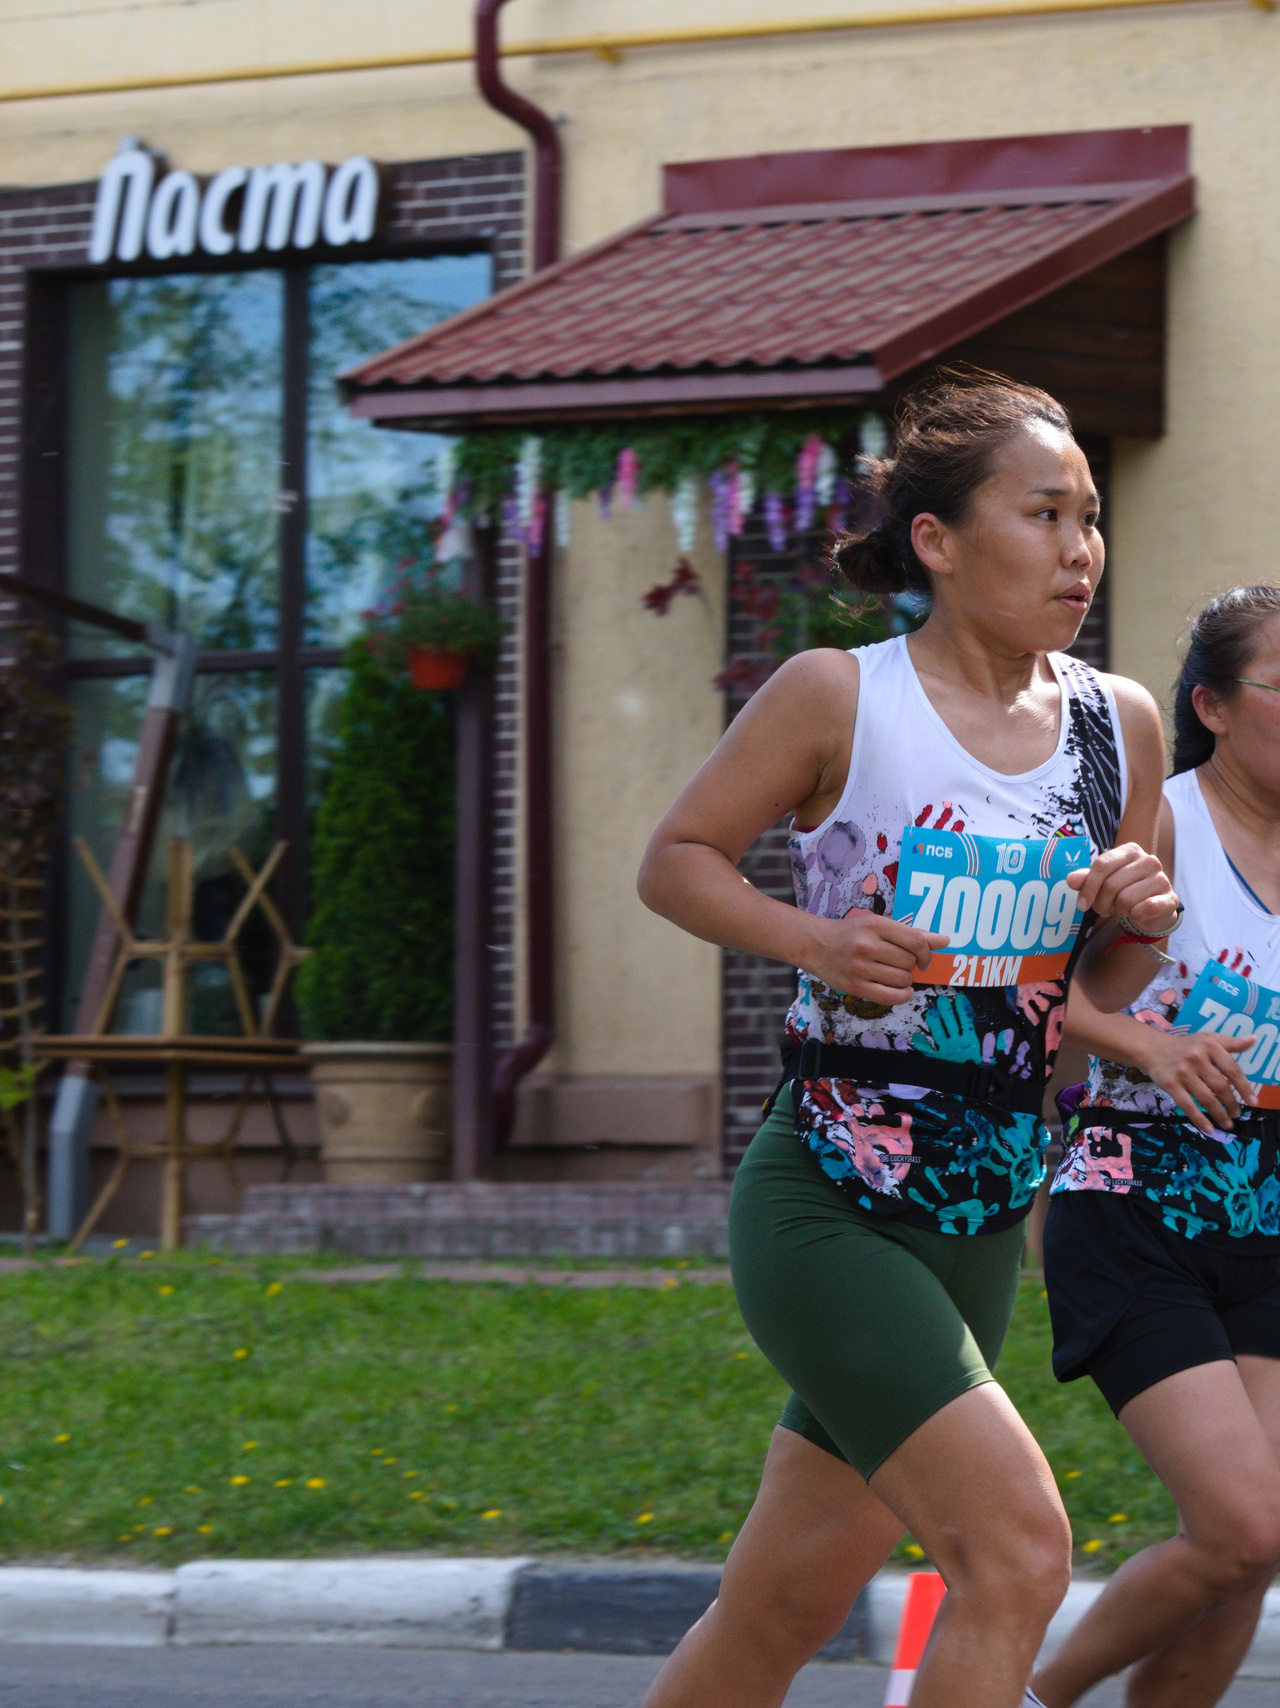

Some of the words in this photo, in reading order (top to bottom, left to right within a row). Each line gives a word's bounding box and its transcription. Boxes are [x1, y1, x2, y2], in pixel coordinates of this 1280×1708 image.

[89, 149, 378, 263] Паста
[926, 844, 953, 859] ПСБ
[996, 843, 1027, 875] 10
[909, 871, 1080, 951] 70009
